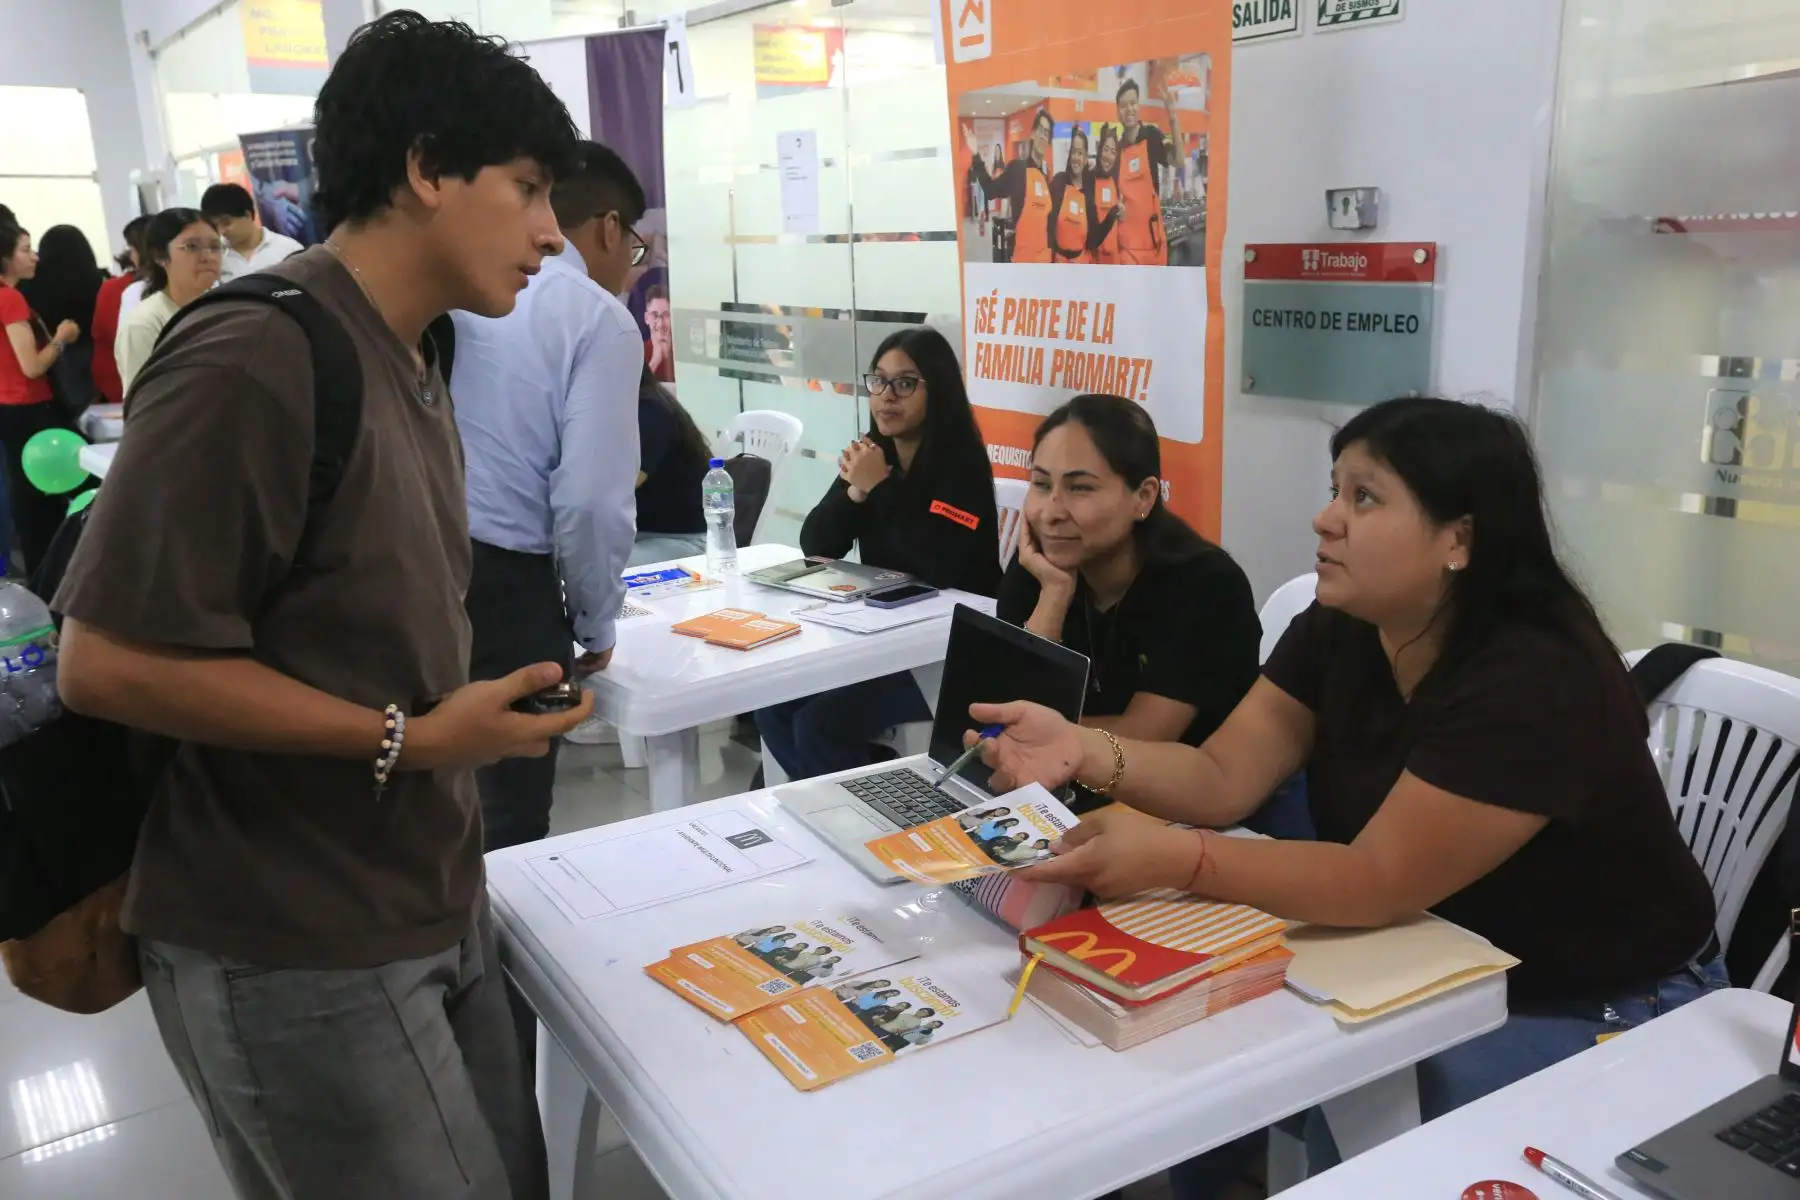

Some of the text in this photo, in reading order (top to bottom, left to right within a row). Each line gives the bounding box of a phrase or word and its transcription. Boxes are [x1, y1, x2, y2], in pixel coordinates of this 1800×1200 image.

[1232, 0, 1292, 28] SALIDA
[1335, 0, 1380, 12] DE SISMOS
[668, 40, 685, 95] 7
[1319, 251, 1368, 272] Trabajo
[974, 287, 1116, 345] ¡SÉ PARTE DE LA
[1252, 308, 1420, 335] CENTRO DE EMPLEO
[974, 341, 1153, 402] FAMILIA PROMART!
[987, 443, 1033, 470] REQUISITO
[1044, 814, 1069, 833] estam
[821, 926, 855, 945] estamos
[927, 985, 961, 1008] estamos
